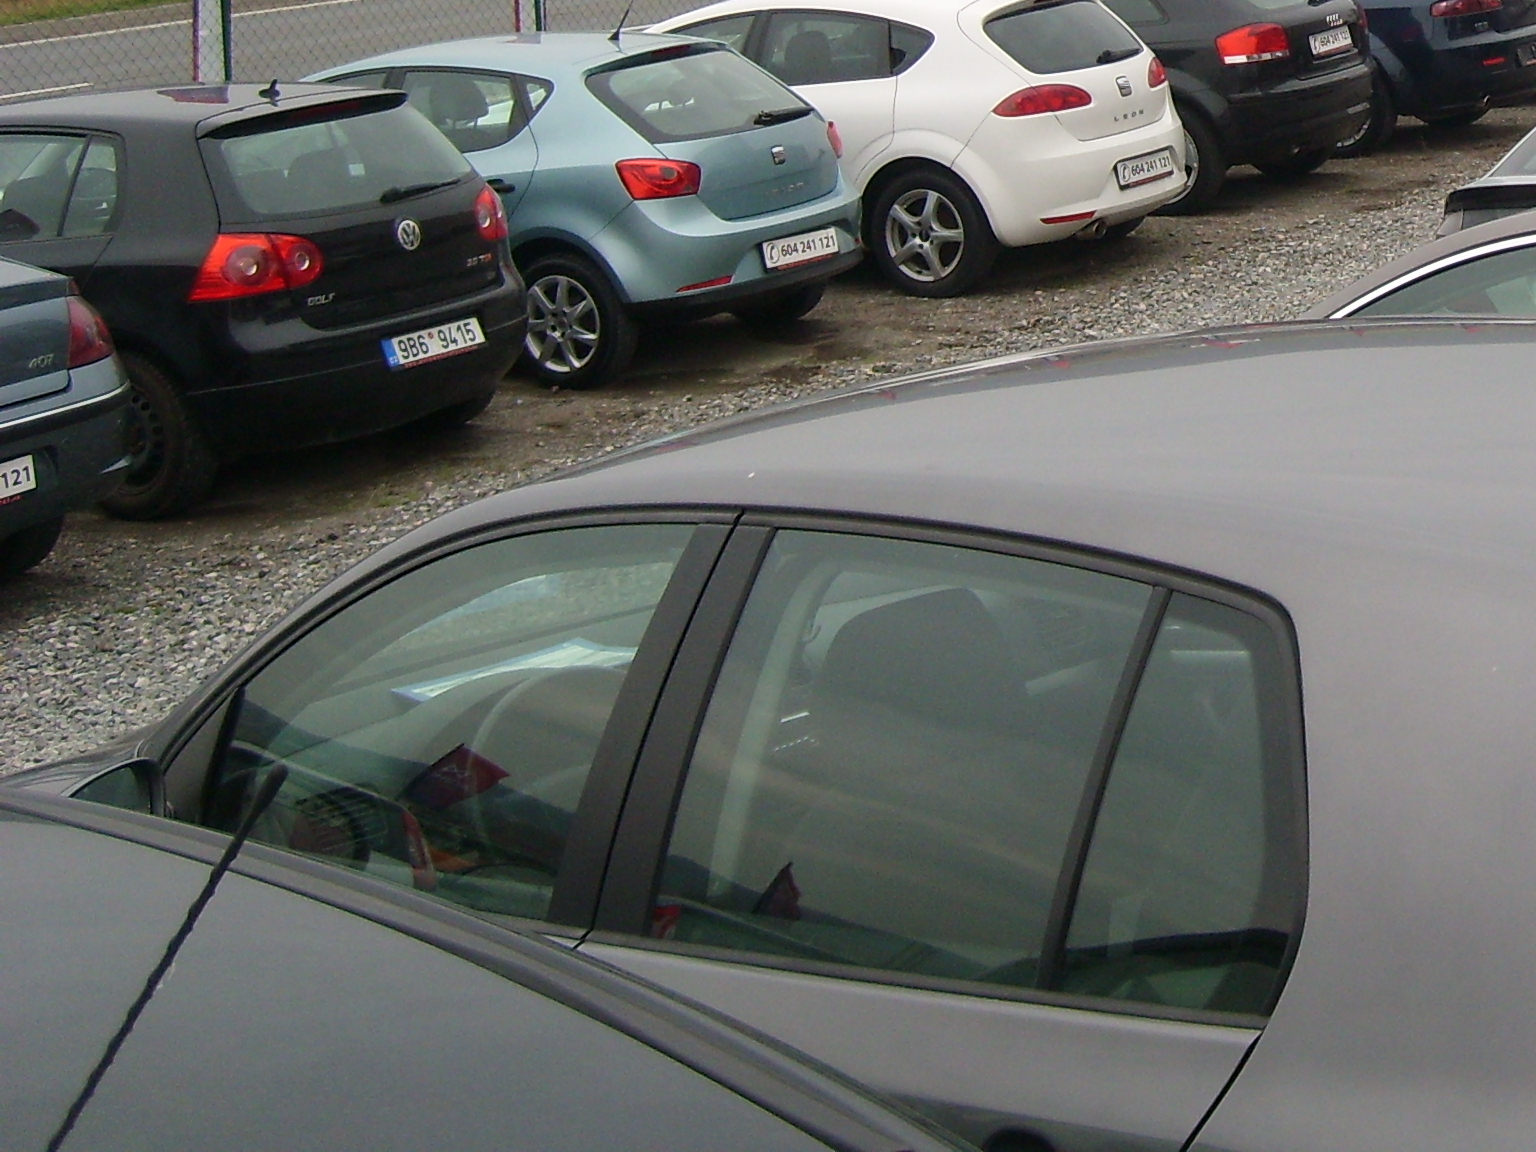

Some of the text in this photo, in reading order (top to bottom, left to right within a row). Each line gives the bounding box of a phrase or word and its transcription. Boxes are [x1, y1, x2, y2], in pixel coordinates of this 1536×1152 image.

[1114, 109, 1144, 122] LEON
[1131, 155, 1171, 176] 604 241 121
[780, 235, 836, 257] 604 241 121
[308, 292, 336, 307] GOLF
[397, 328, 430, 360] 9B6
[438, 321, 477, 350] 9415
[0, 465, 31, 489] 121
